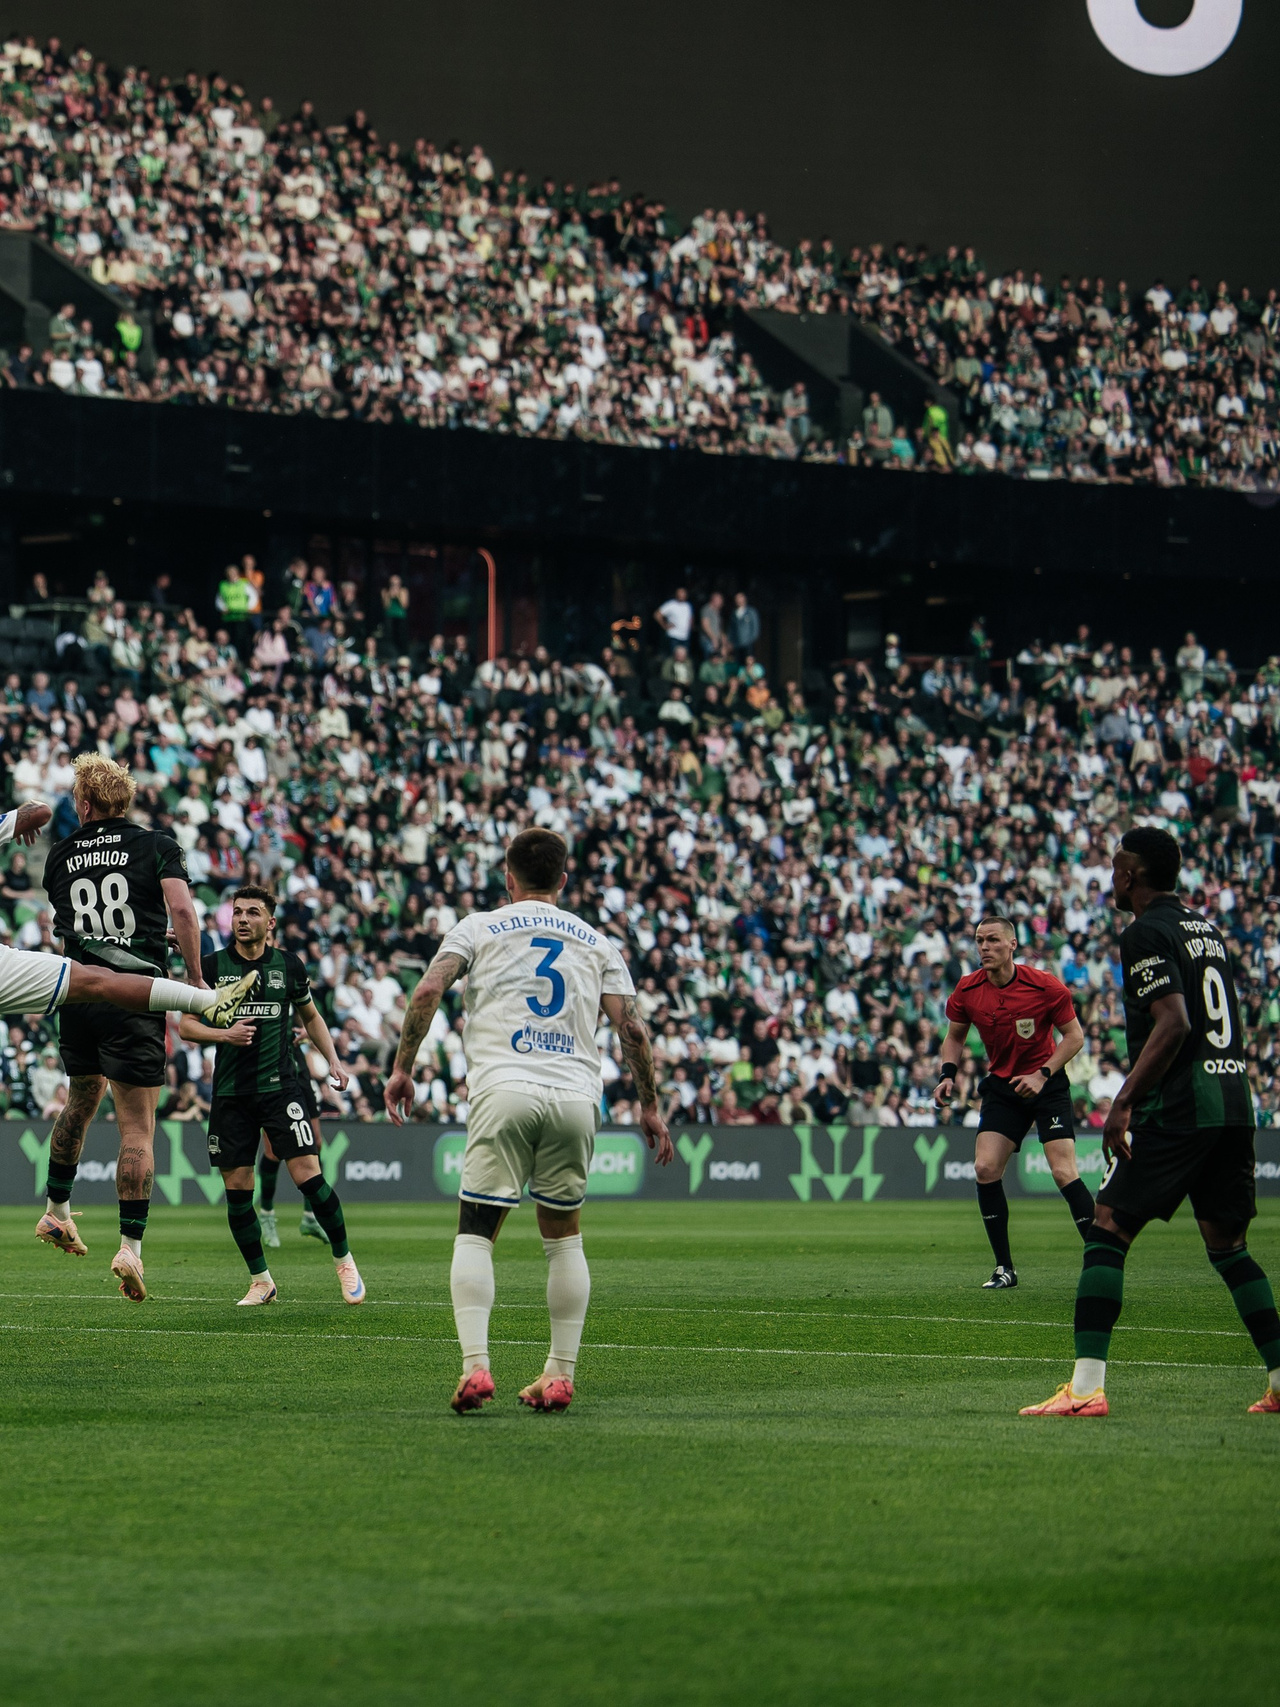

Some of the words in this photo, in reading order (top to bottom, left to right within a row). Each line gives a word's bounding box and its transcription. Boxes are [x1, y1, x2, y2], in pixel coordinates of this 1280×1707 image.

[66, 851, 129, 874] КРИВЦОВ
[70, 873, 136, 938] 88
[487, 916, 598, 946] ВЕДЕРНИКОВ
[1129, 955, 1166, 977] ABSEL
[526, 937, 566, 1018] 3
[1137, 975, 1171, 997] Constell
[235, 1005, 270, 1016] INLINE
[1202, 966, 1232, 1049] 9
[532, 1030, 575, 1048] ГАЗПРОМ
[1203, 1058, 1247, 1074] OZON
[289, 1120, 314, 1148] 10
[75, 1160, 117, 1182] ФЛ
[345, 1160, 403, 1181] ЮФЛ
[708, 1160, 761, 1181] ЮФЛ
